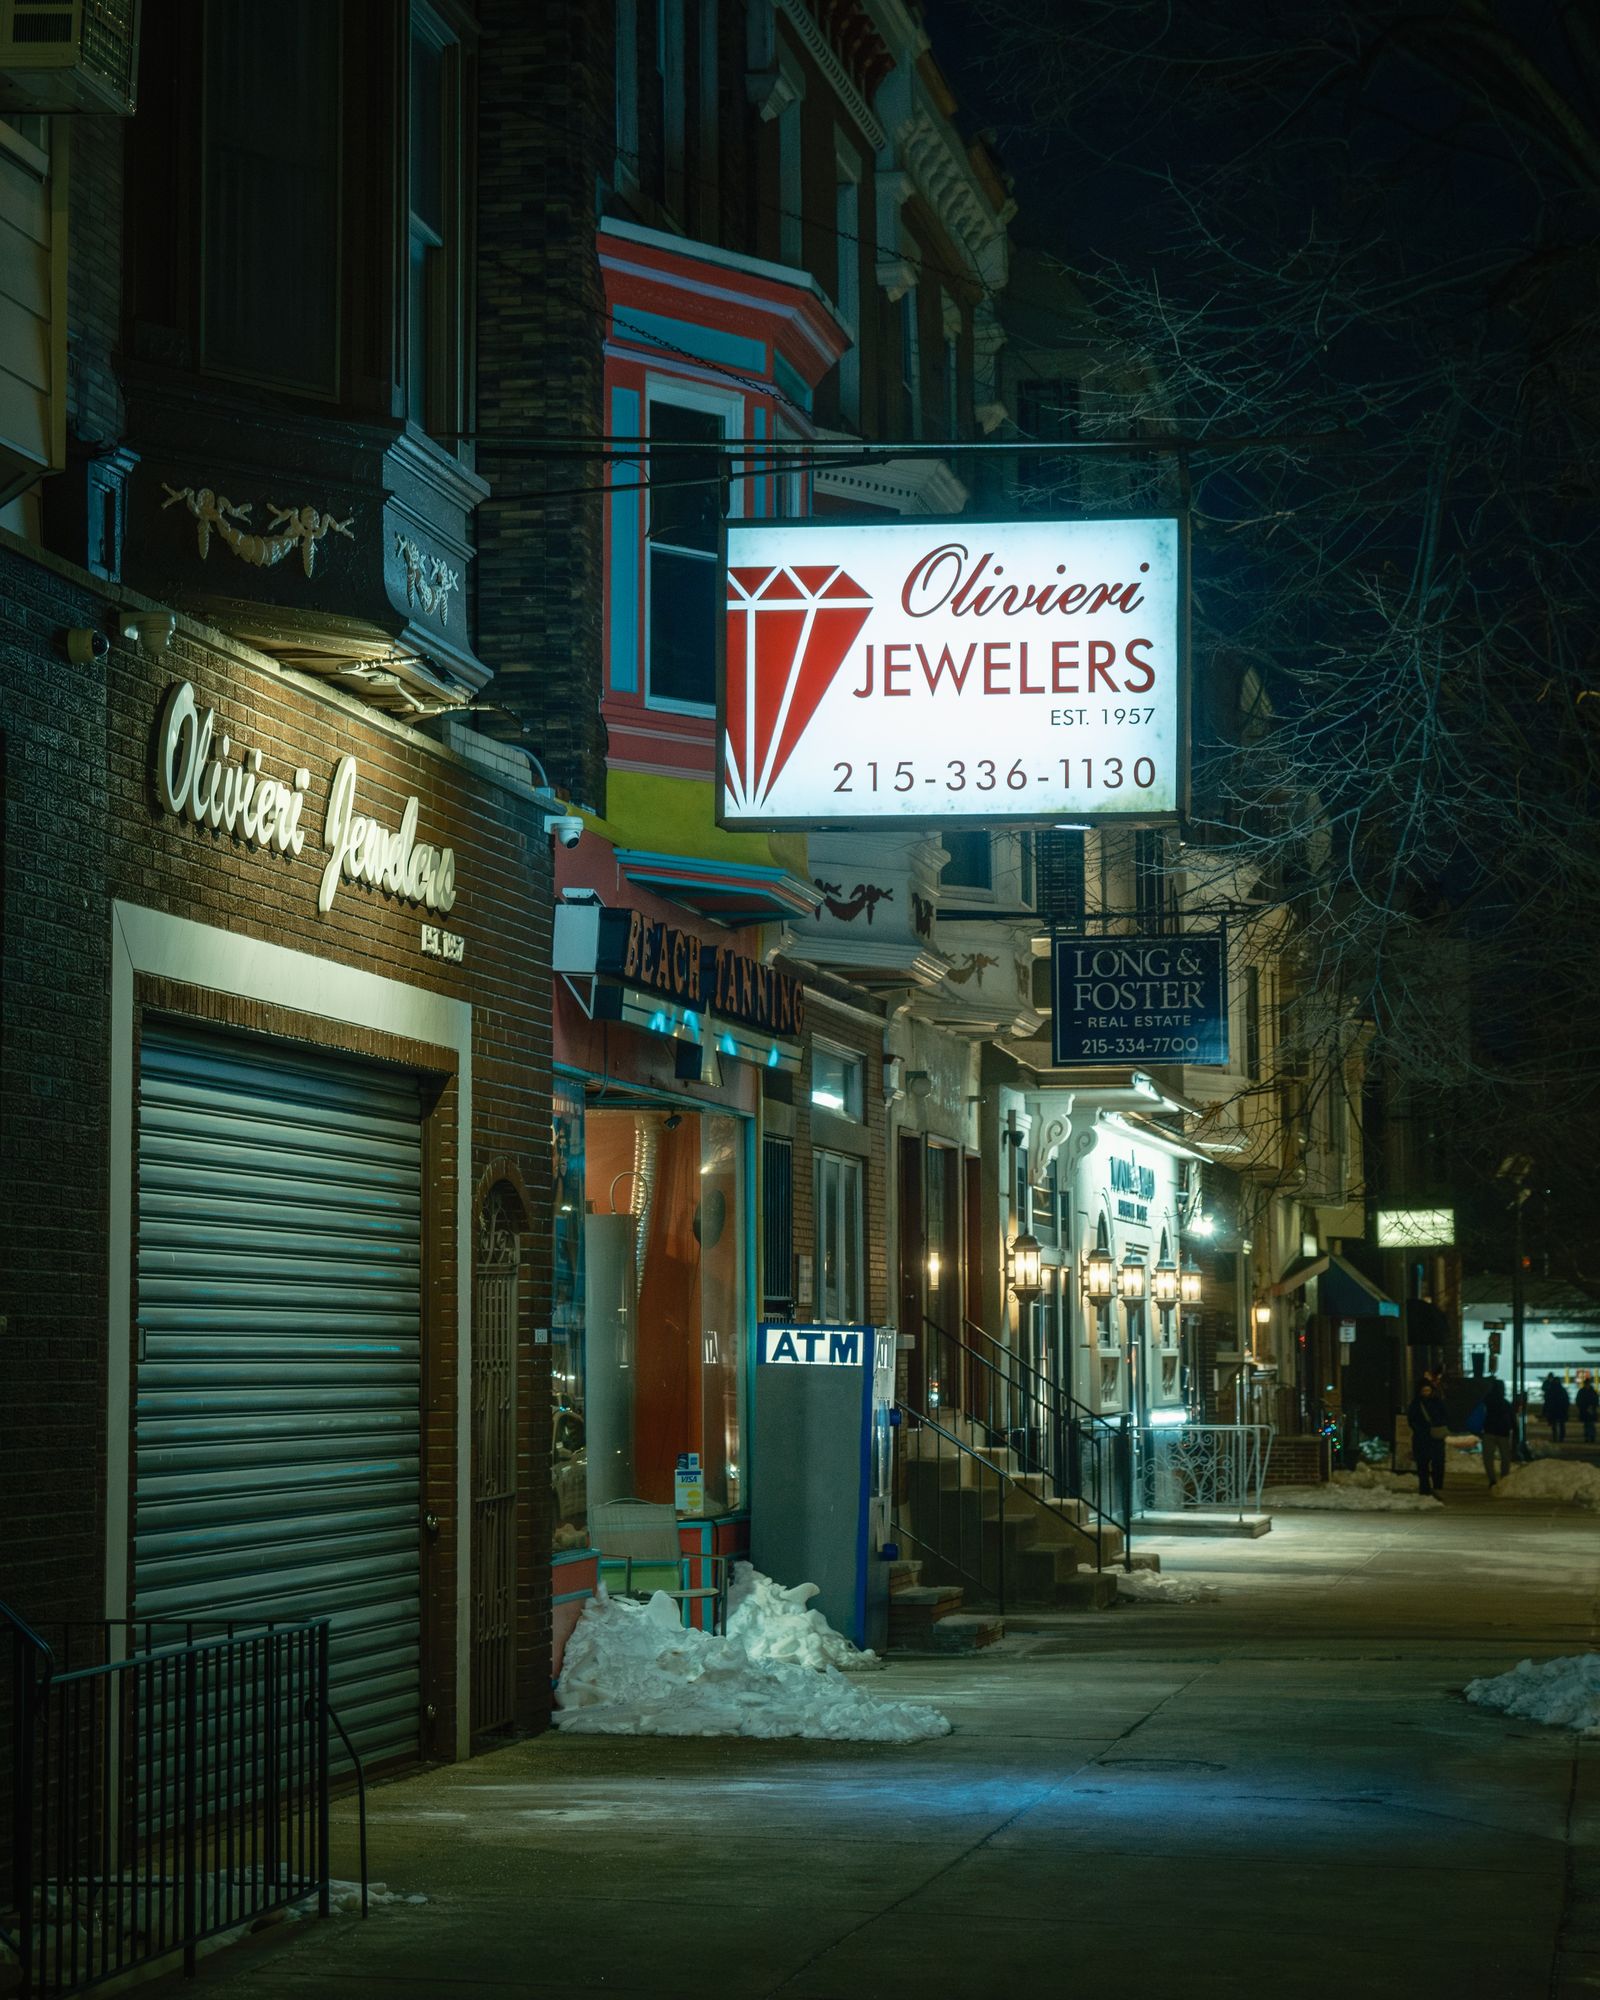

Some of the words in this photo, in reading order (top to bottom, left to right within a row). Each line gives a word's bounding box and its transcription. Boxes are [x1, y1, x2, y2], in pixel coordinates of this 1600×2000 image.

[902, 543, 1150, 617] Olivieri
[853, 638, 1156, 699] JEWELERS
[1051, 710, 1090, 726] EST.
[1101, 708, 1155, 725] 1957
[158, 682, 310, 856] Olivieri
[833, 757, 1156, 793] 215-336-1130
[624, 910, 702, 1001] BEACH
[715, 949, 804, 1036] TANNING
[1074, 949, 1171, 978] LONG
[1177, 947, 1204, 976] &
[1073, 981, 1205, 1011] FOSTER
[1088, 1016, 1128, 1028] REAL
[1134, 1015, 1191, 1027] ESTATE
[1081, 1037, 1199, 1054] 215-334-7700
[771, 1331, 860, 1364] ATM
[681, 1475, 698, 1483] VISA
